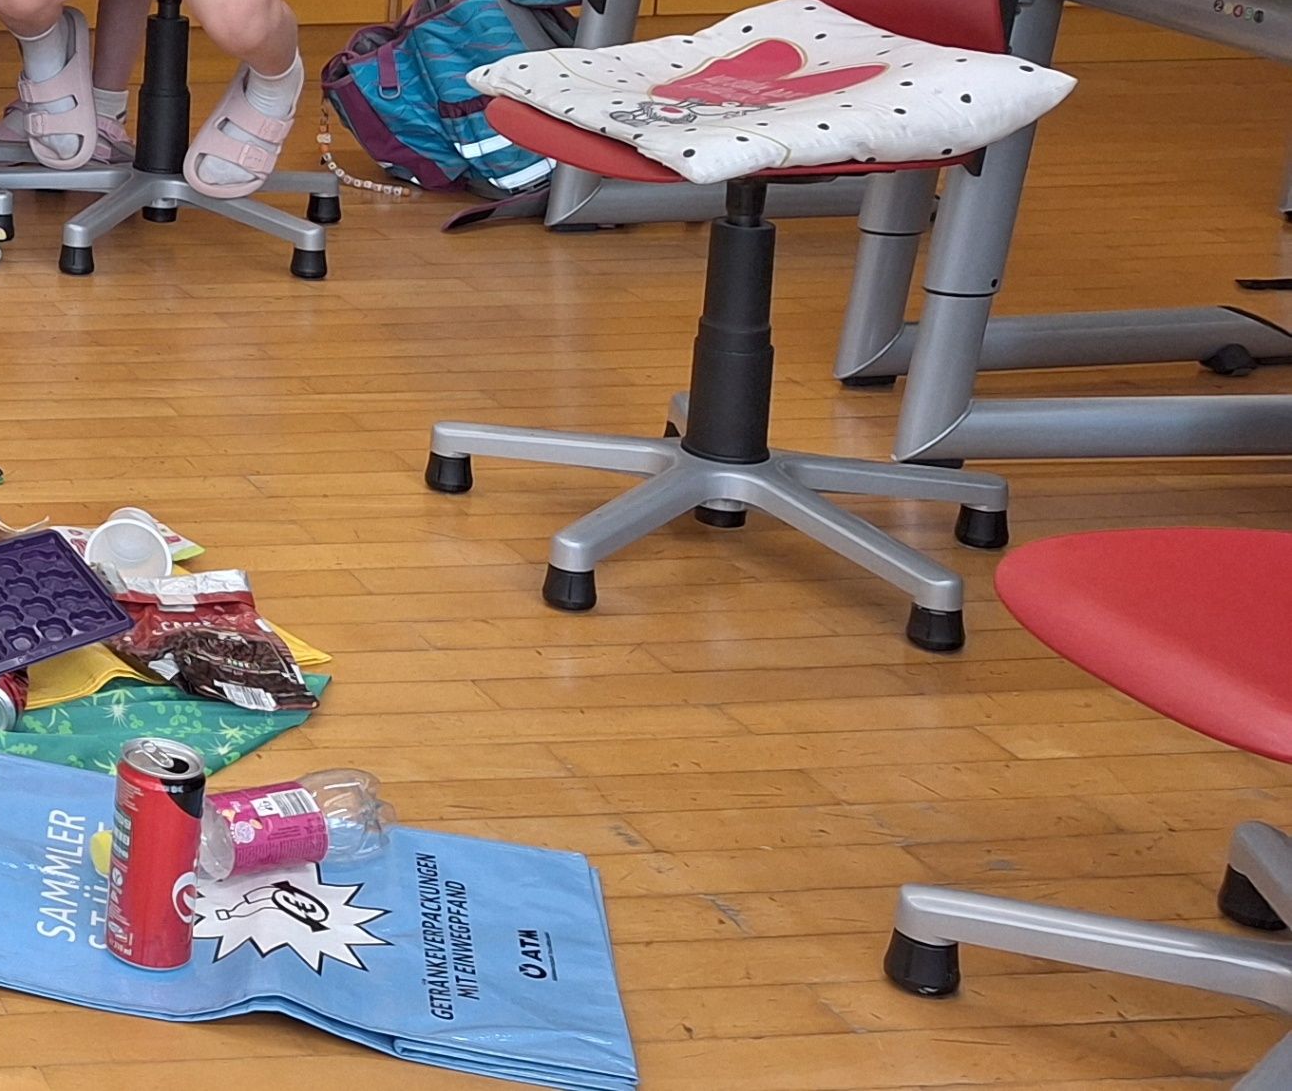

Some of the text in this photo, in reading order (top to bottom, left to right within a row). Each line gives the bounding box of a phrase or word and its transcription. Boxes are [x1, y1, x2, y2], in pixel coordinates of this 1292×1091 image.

[36, 809, 86, 943] SAMMLER
[415, 852, 454, 1021] GETRÄNKEVERPACKUNGEN
[444, 880, 480, 1000] MIT EINWEGPFAND
[517, 929, 543, 962] ATM
